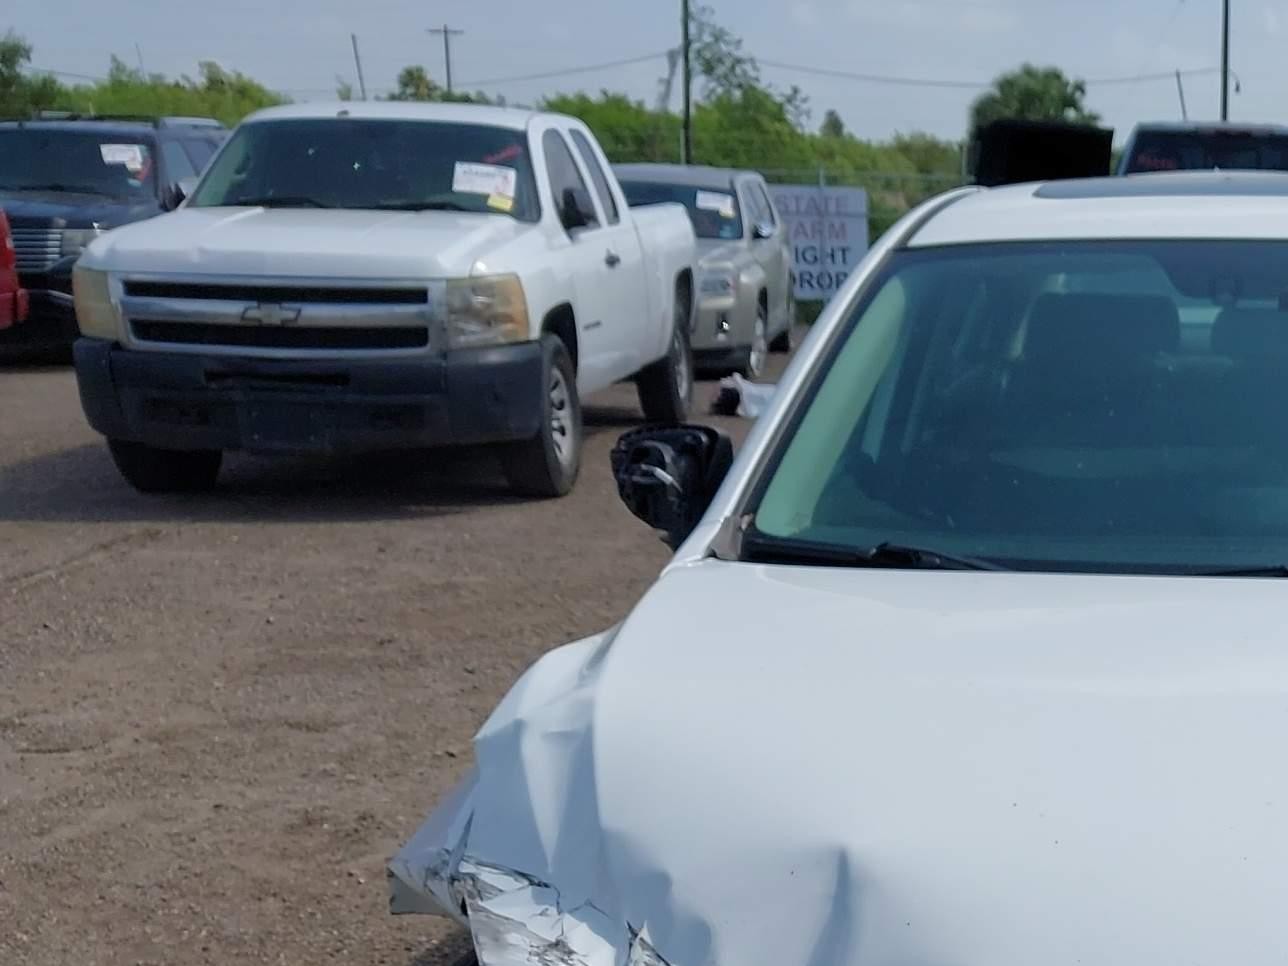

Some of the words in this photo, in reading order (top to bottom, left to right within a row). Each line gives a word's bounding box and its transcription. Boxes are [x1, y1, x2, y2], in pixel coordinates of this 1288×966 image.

[774, 194, 848, 216] STATE
[792, 220, 848, 240] ARM
[794, 246, 851, 265] IGHT
